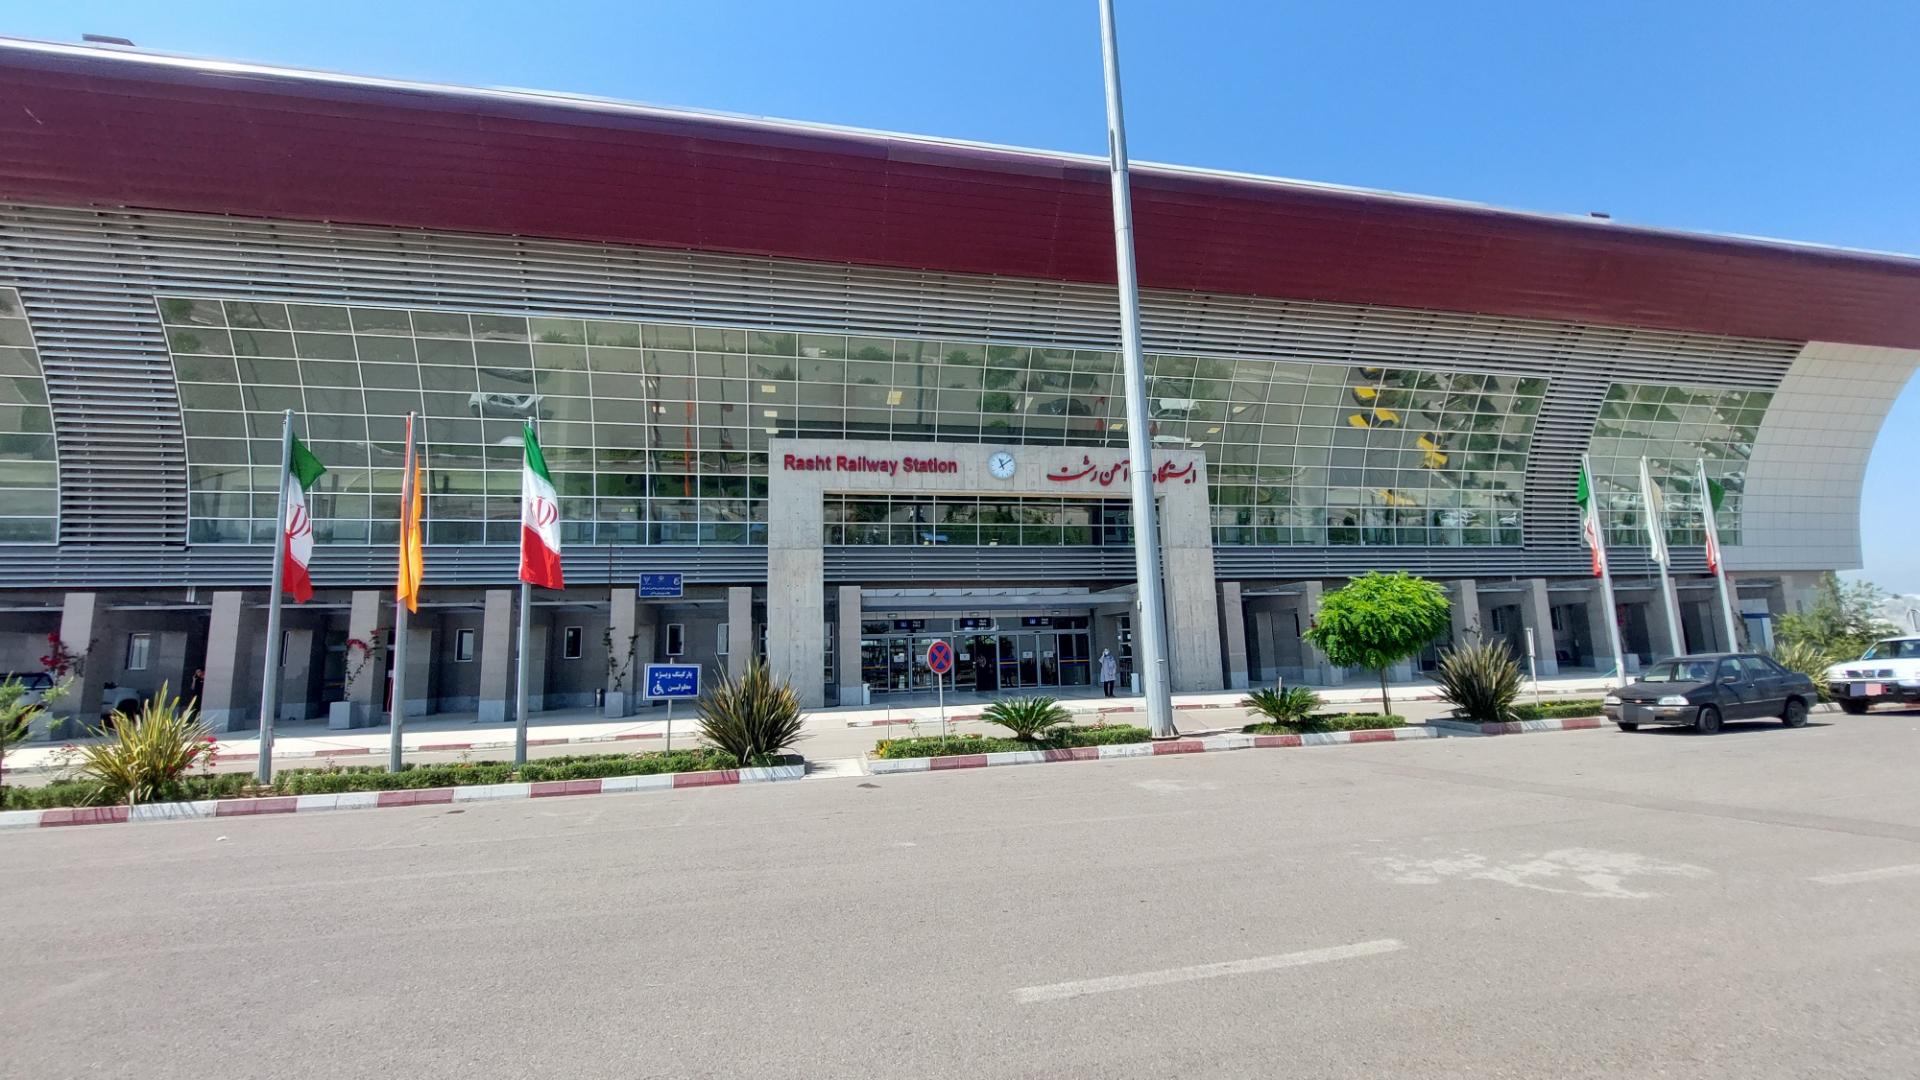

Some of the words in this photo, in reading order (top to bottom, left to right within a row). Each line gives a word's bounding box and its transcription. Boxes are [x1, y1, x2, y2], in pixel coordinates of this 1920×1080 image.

[784, 454, 832, 471] Rasht
[836, 455, 898, 477] Railway
[903, 456, 958, 473] Station
[1046, 454, 1099, 482] رشت
